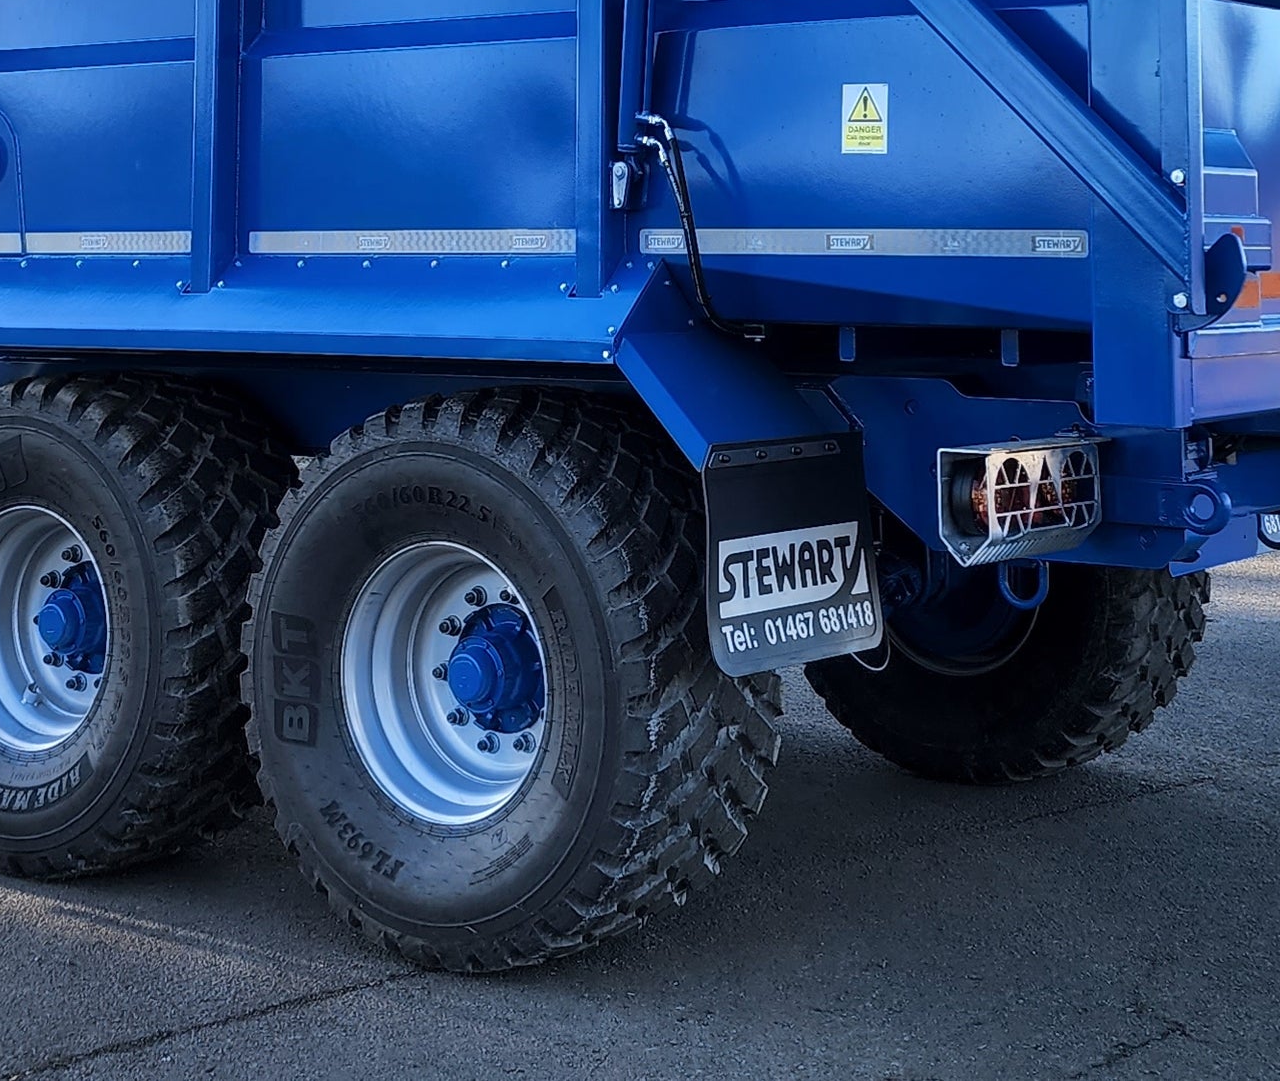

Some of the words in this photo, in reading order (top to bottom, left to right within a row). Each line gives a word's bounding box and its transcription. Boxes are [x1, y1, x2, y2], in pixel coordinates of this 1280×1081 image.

[847, 125, 882, 134] DANGER
[830, 235, 870, 250] STEWART
[1036, 237, 1082, 252] STEWART
[719, 527, 865, 603] STEWART
[722, 622, 759, 654] Tel:
[764, 611, 815, 646] 01467
[819, 600, 874, 635] 681418
